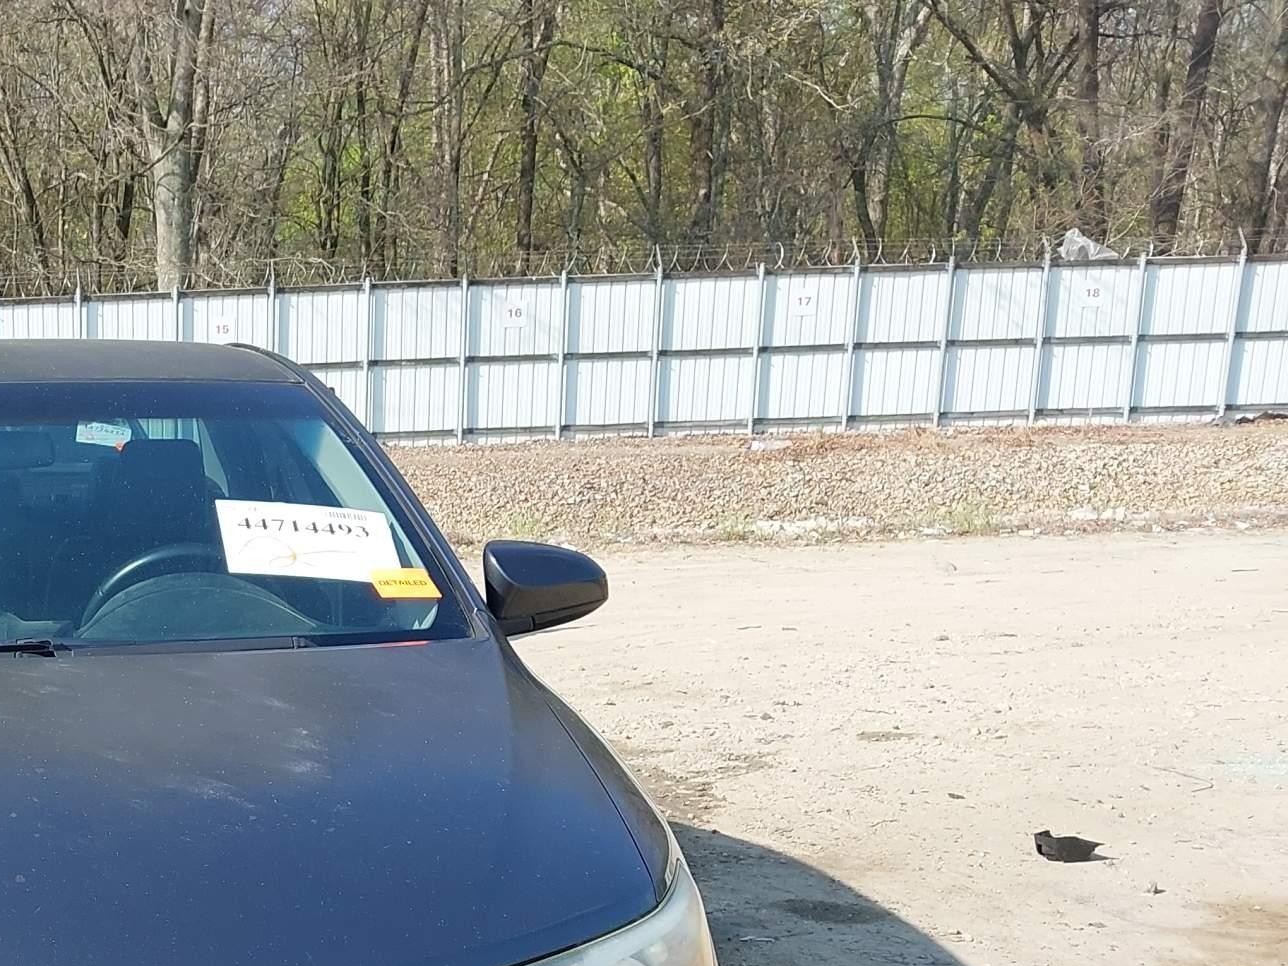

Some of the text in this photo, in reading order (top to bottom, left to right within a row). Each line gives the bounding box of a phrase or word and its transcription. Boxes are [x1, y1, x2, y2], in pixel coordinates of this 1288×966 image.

[1085, 287, 1101, 298] 18
[797, 296, 812, 306] 17
[507, 307, 522, 318] 16
[215, 324, 230, 335] 15
[237, 517, 370, 538] 44714493
